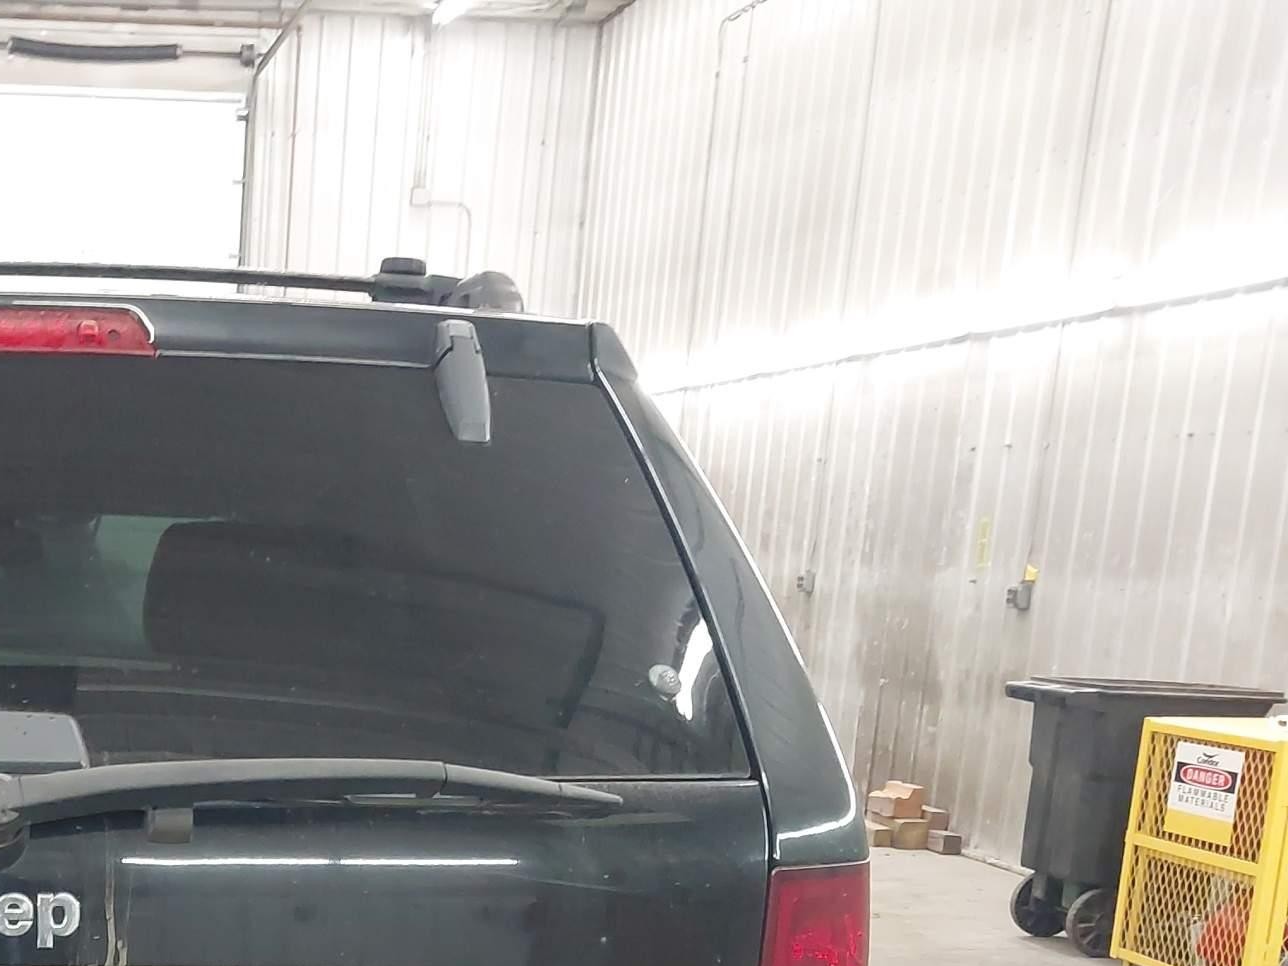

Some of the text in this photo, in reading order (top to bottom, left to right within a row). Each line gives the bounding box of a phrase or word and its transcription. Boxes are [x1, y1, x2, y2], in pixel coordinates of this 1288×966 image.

[1186, 768, 1226, 787] DANGER
[1177, 784, 1230, 803] FLAMMABLE
[1177, 794, 1225, 812] MATERIALS
